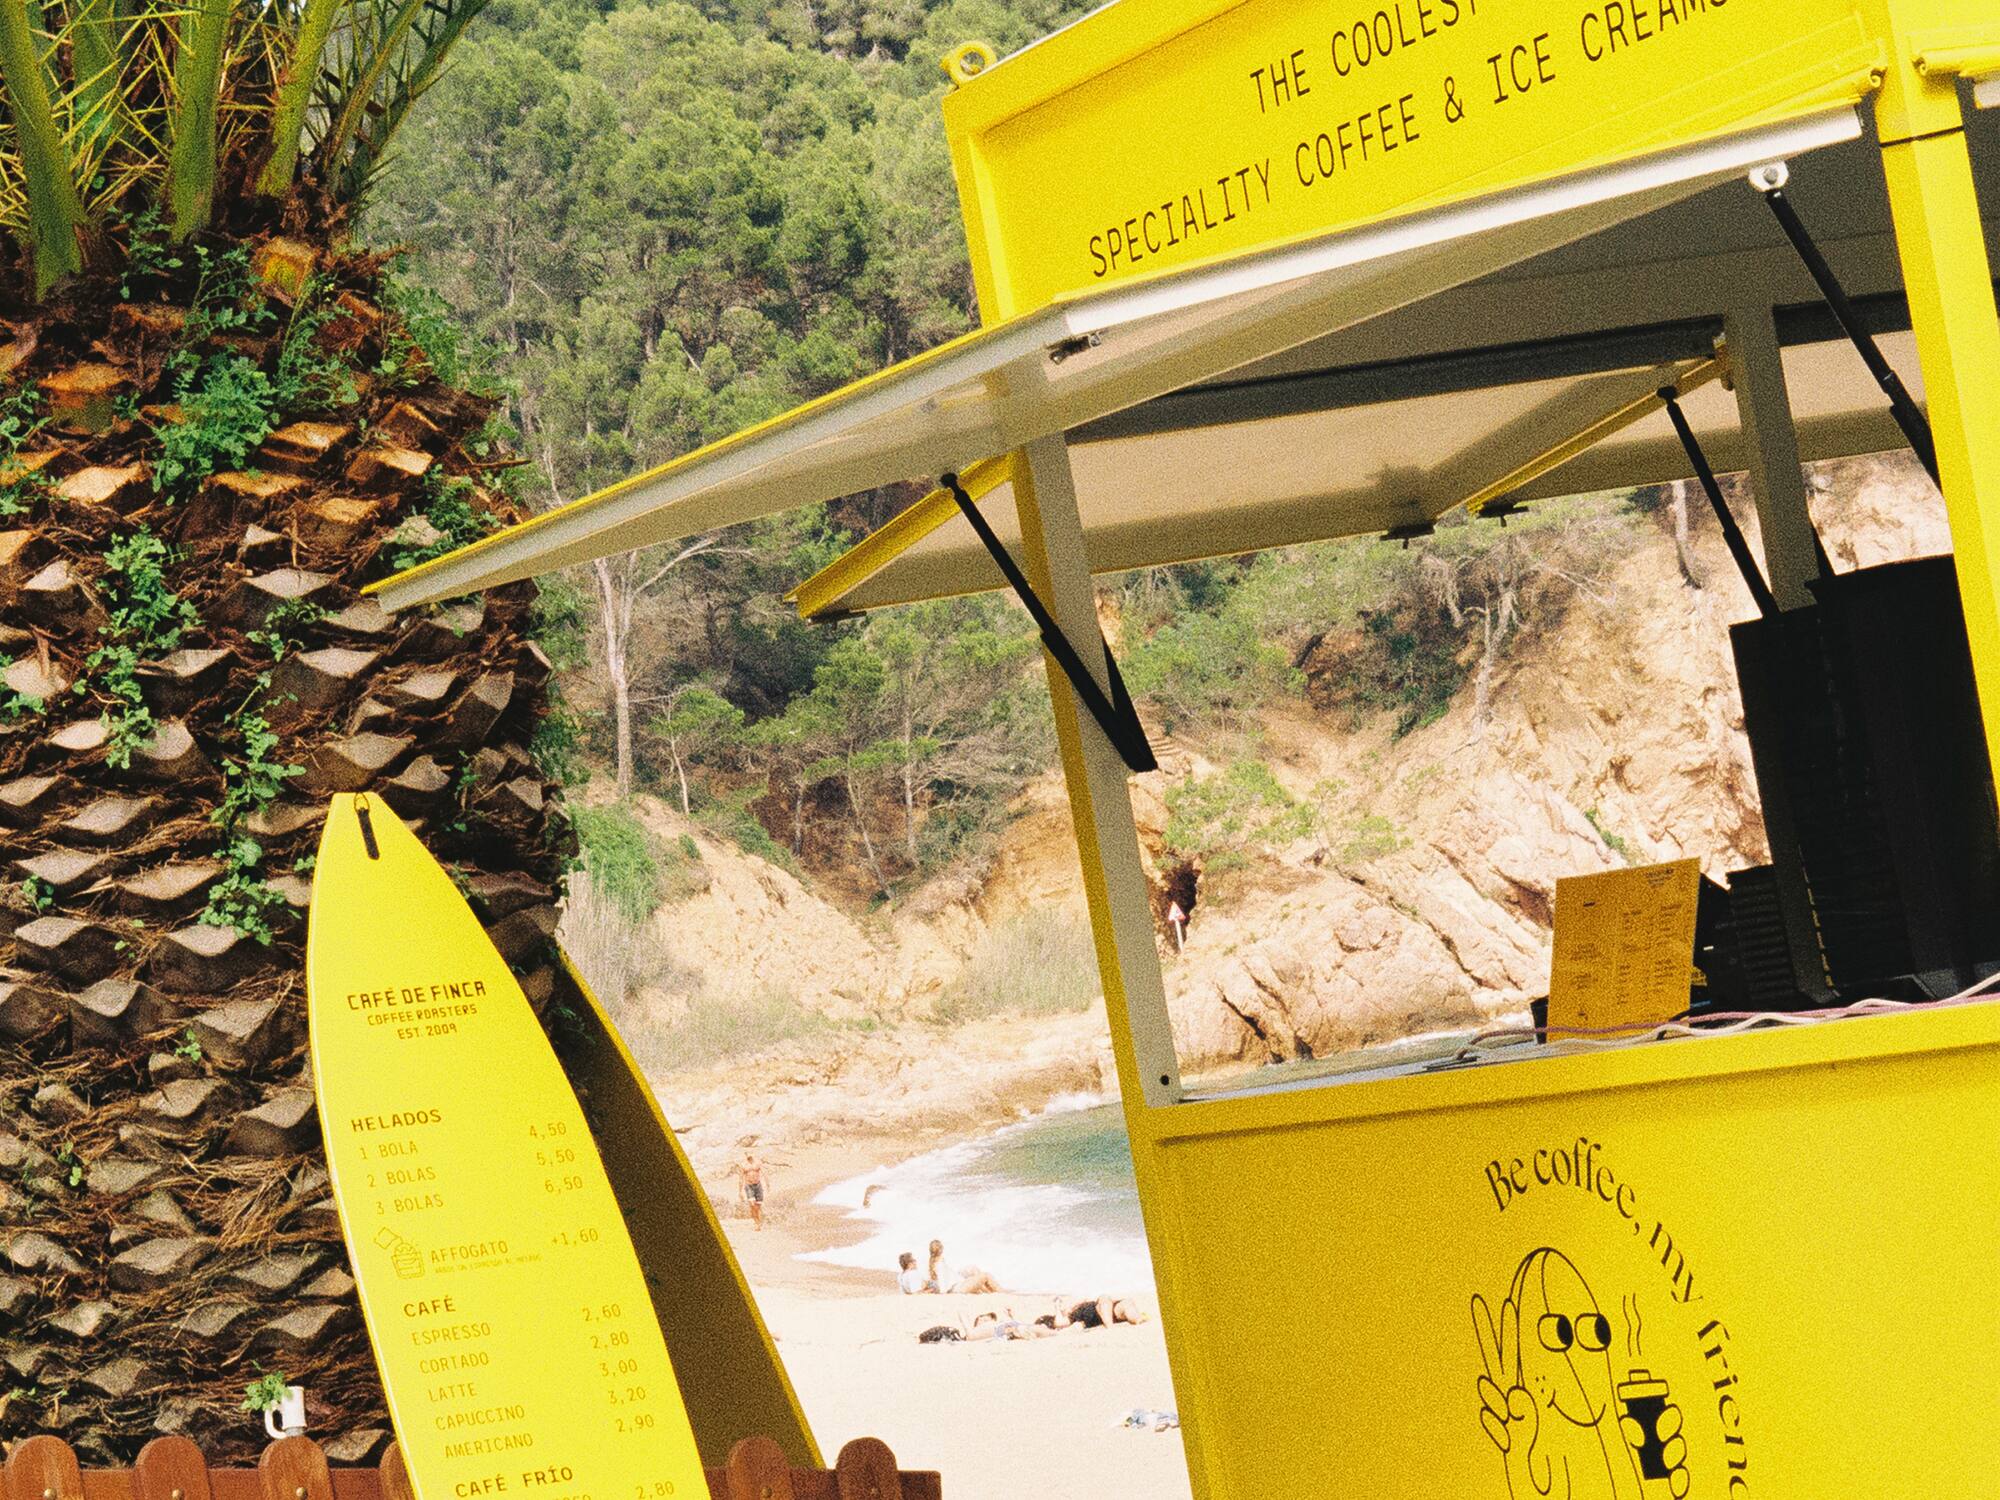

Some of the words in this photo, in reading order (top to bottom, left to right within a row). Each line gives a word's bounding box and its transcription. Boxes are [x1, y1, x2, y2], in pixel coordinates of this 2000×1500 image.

[1249, 49, 1311, 114] THE
[1089, 158, 1271, 278] SPECIALITY
[1295, 93, 1421, 187] COFFEE
[1444, 76, 1465, 123] &
[1486, 33, 1556, 104] ICE
[1580, 0, 1728, 62] CREA
[347, 987, 397, 1010] CAFÉ
[401, 987, 427, 1004] DE
[430, 980, 487, 1001] FINCA
[367, 1010, 414, 1026] COFFEE
[416, 1003, 478, 1020] ROASTERS
[426, 1022, 458, 1036] 2009
[351, 1108, 443, 1133] HELADOS
[360, 1146, 368, 1161] 1
[379, 1140, 419, 1158] BOLA
[529, 1121, 568, 1140] 4,50
[367, 1174, 376, 1188] 2
[387, 1166, 437, 1186] BOLAS
[537, 1148, 576, 1168] 5,50
[375, 1202, 385, 1216] 3
[394, 1193, 445, 1214] BOLAS
[545, 1175, 584, 1196] 6,50
[1485, 1157, 1528, 1213] Be
[1533, 1136, 1641, 1236] coffee,
[1649, 1221, 1704, 1304] my
[430, 1240, 509, 1264] AFFOGATO
[403, 1295, 457, 1318] CAFÉ
[411, 1322, 491, 1346] ESPRESSO
[582, 1303, 622, 1323] 2,60
[419, 1351, 490, 1375] CORTADO
[590, 1330, 630, 1350] 2,80
[428, 1382, 477, 1403] LATTE
[600, 1358, 638, 1378] 3,00
[435, 1404, 525, 1431] CAPUCCINO
[608, 1385, 646, 1406] 3,20
[444, 1432, 534, 1459] AMERICANO
[616, 1413, 655, 1434] 2,90
[455, 1473, 507, 1498] CAFÉ
[522, 1465, 573, 1488] FRÍO
[635, 1480, 675, 1500] 2,80
